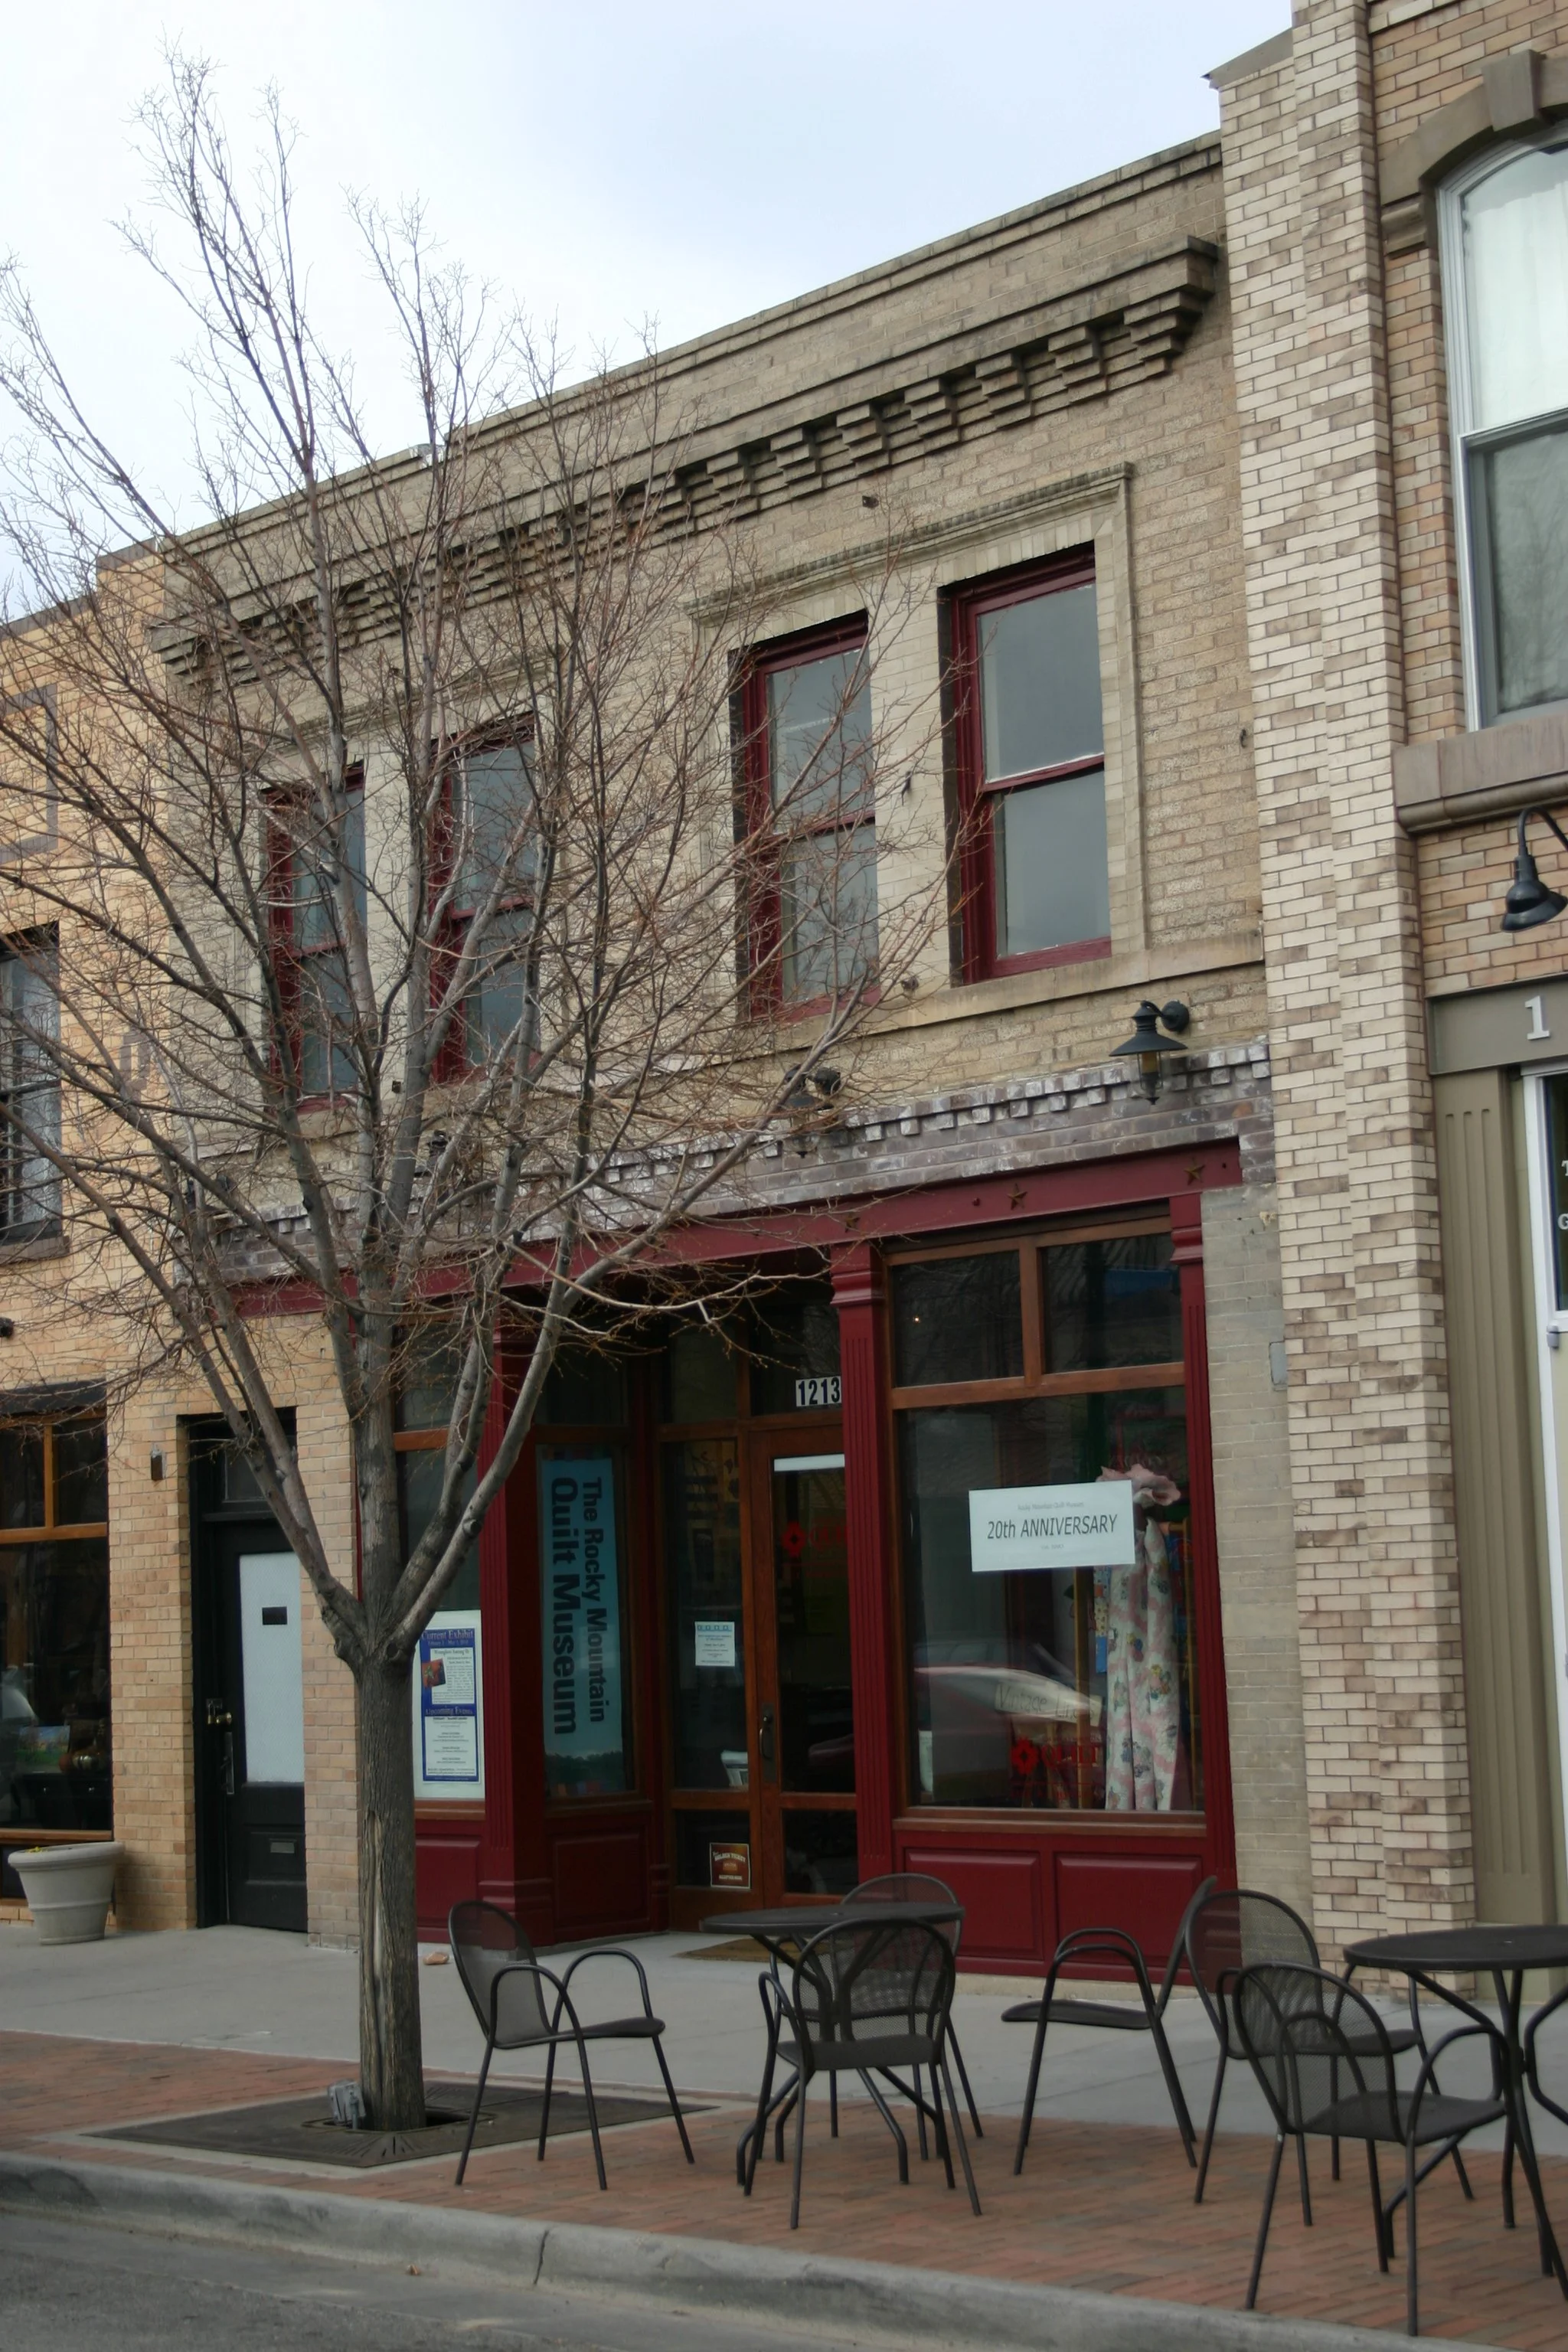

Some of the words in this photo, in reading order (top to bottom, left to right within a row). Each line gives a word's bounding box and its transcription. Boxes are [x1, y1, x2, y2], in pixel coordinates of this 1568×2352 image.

[1525, 995, 1550, 1040] 1
[799, 1377, 840, 1405] 1213
[551, 1477, 580, 1565] Quilt
[582, 1477, 603, 1522] The
[987, 1519, 1016, 1540] 20th
[1021, 1514, 1118, 1538] ANNIVERSARY
[583, 1528, 605, 1602] Rocky
[421, 1630, 447, 1641] Current
[449, 1628, 474, 1639] Exhibit
[553, 1574, 580, 1734] Museum
[586, 1609, 610, 1723] Mountain
[426, 1706, 454, 1717] Upcoming
[456, 1706, 474, 1715] Events
[1000, 1684, 1047, 1714] Vintage
